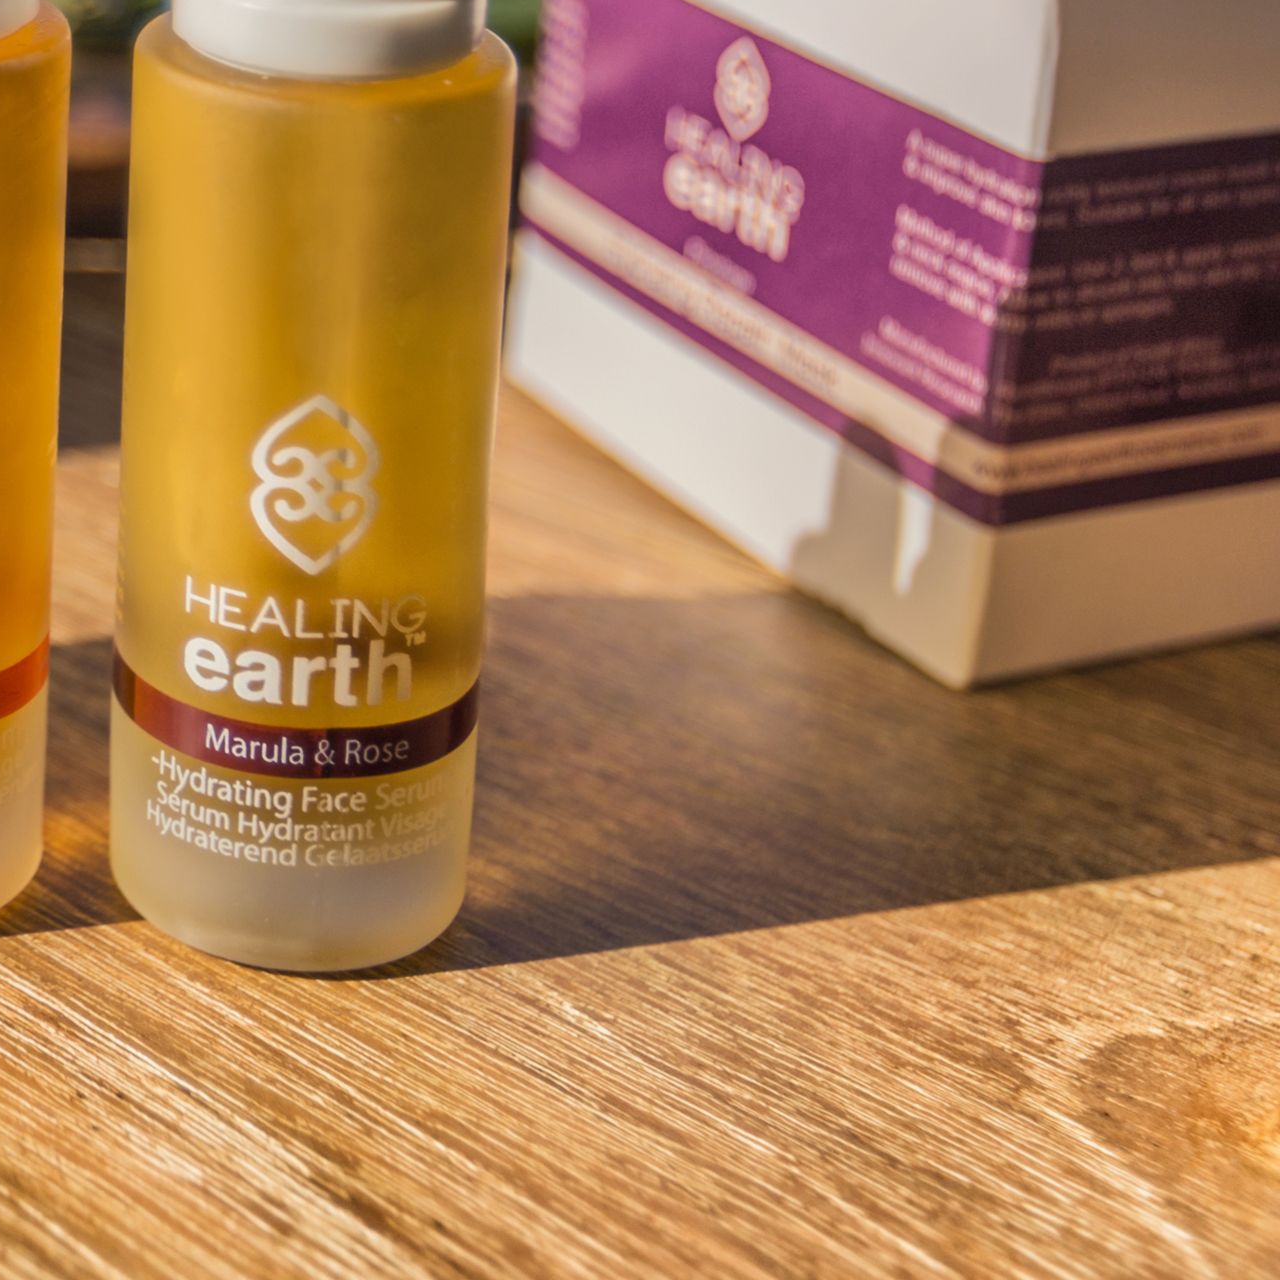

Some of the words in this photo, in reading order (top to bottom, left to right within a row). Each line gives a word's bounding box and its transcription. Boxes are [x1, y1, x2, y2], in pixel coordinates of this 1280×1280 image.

[186, 575, 428, 639] HEALING
[184, 636, 412, 706] earth
[204, 723, 305, 765] Marula
[314, 739, 336, 766] &
[344, 738, 410, 765] Rose
[302, 785, 368, 813] Face
[147, 799, 297, 867] Hydraterend
[238, 810, 374, 843] Hydratant
